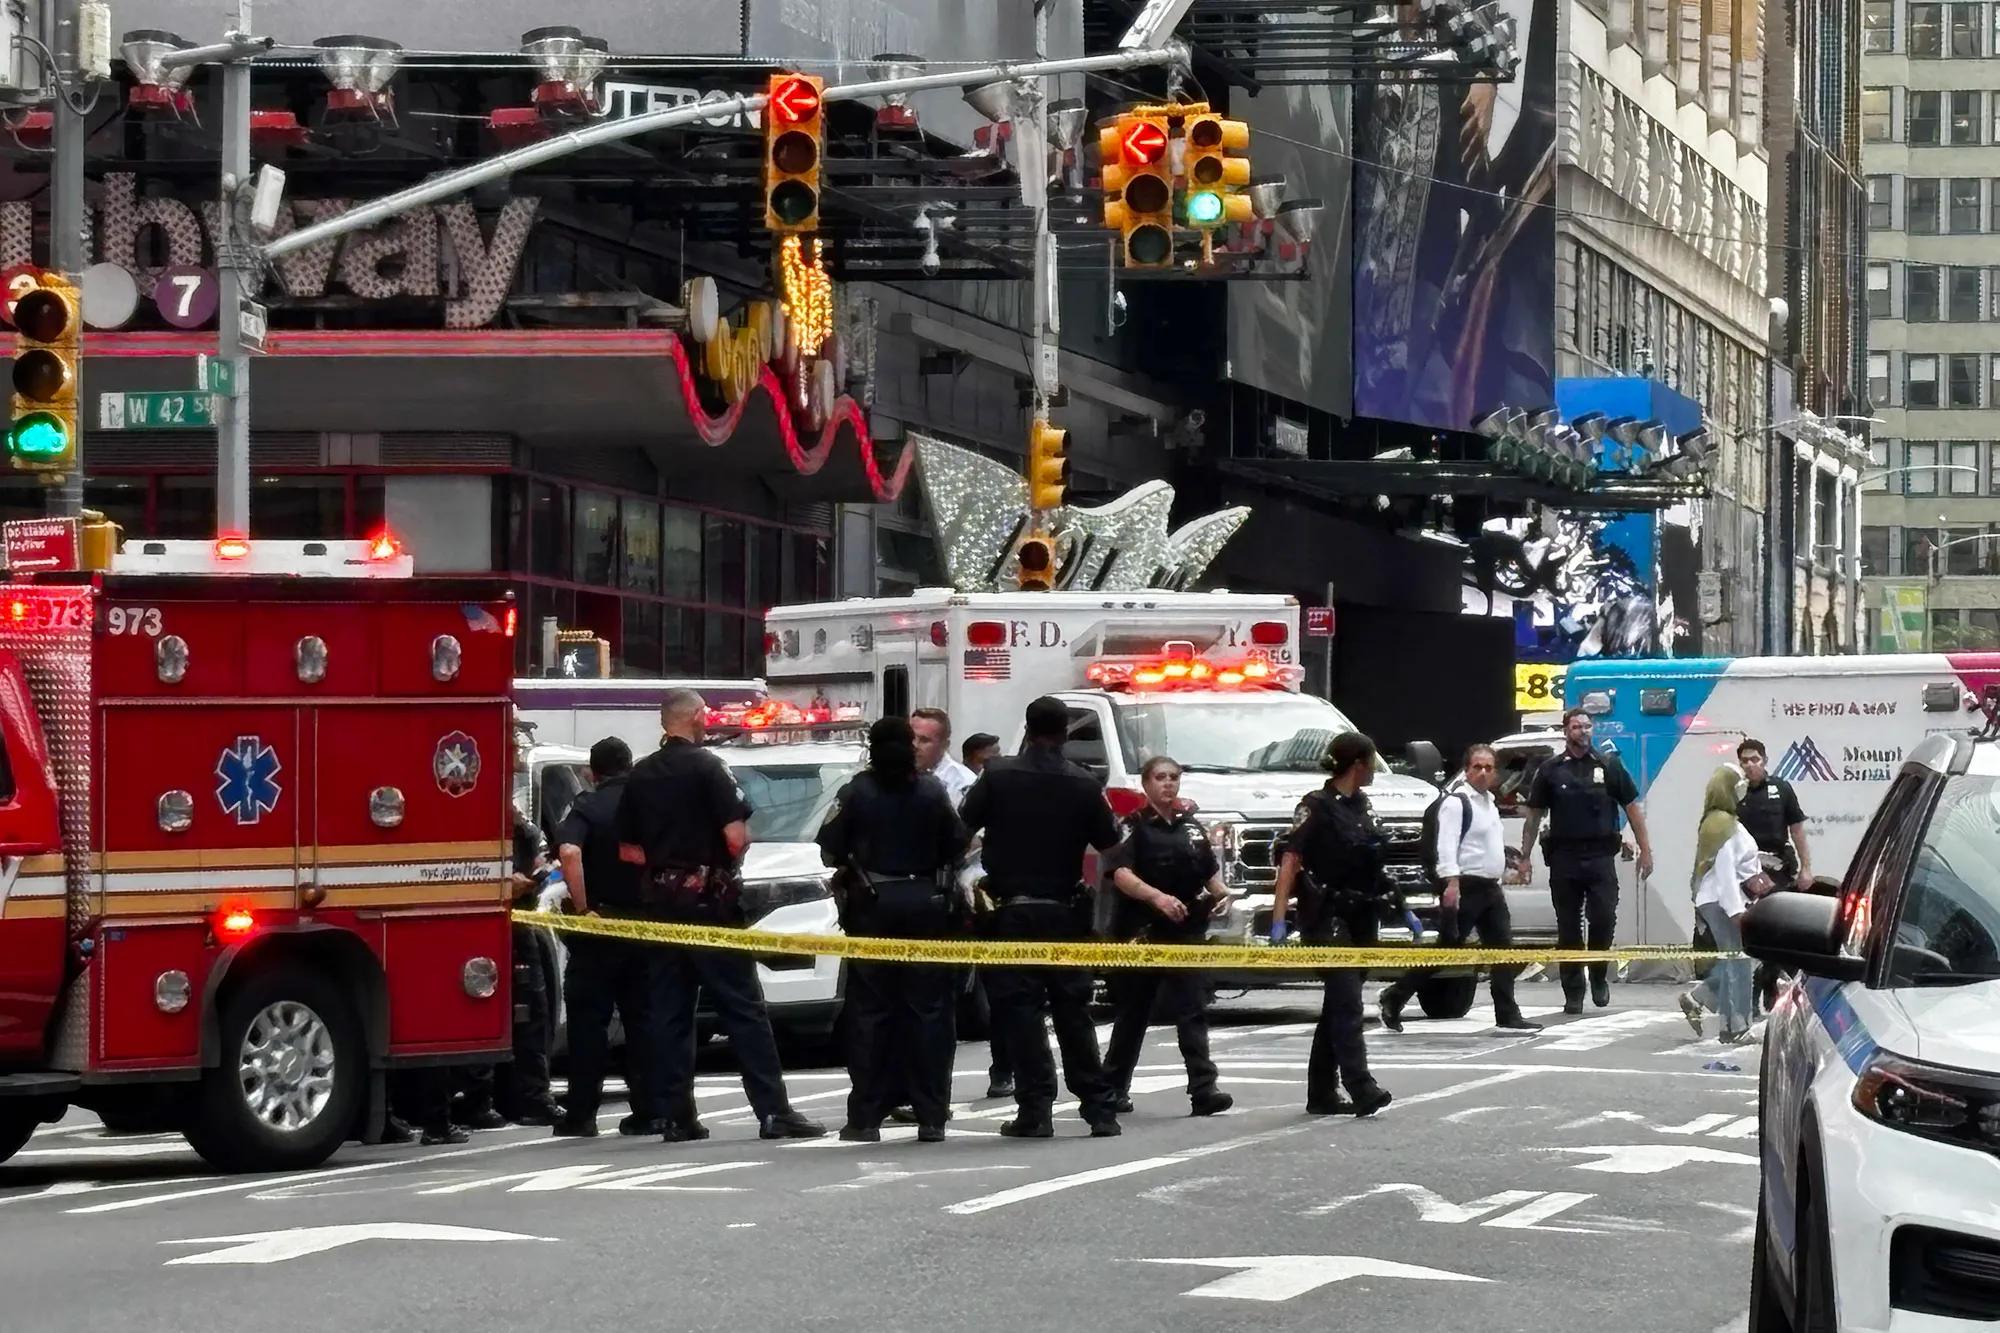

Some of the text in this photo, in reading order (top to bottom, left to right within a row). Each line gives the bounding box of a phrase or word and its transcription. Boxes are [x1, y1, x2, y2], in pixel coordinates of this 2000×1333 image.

[171, 275, 201, 317] 7
[129, 397, 148, 424] W
[159, 396, 185, 423] 42
[37, 600, 84, 627] 973
[108, 607, 163, 636] 973
[1040, 621, 1068, 648] D.
[1808, 702, 1844, 716] FIND
[1848, 701, 1860, 716] A
[1863, 701, 1897, 716] WAY
[1843, 746, 1902, 762] Mount
[1843, 764, 1891, 781] Sinai
